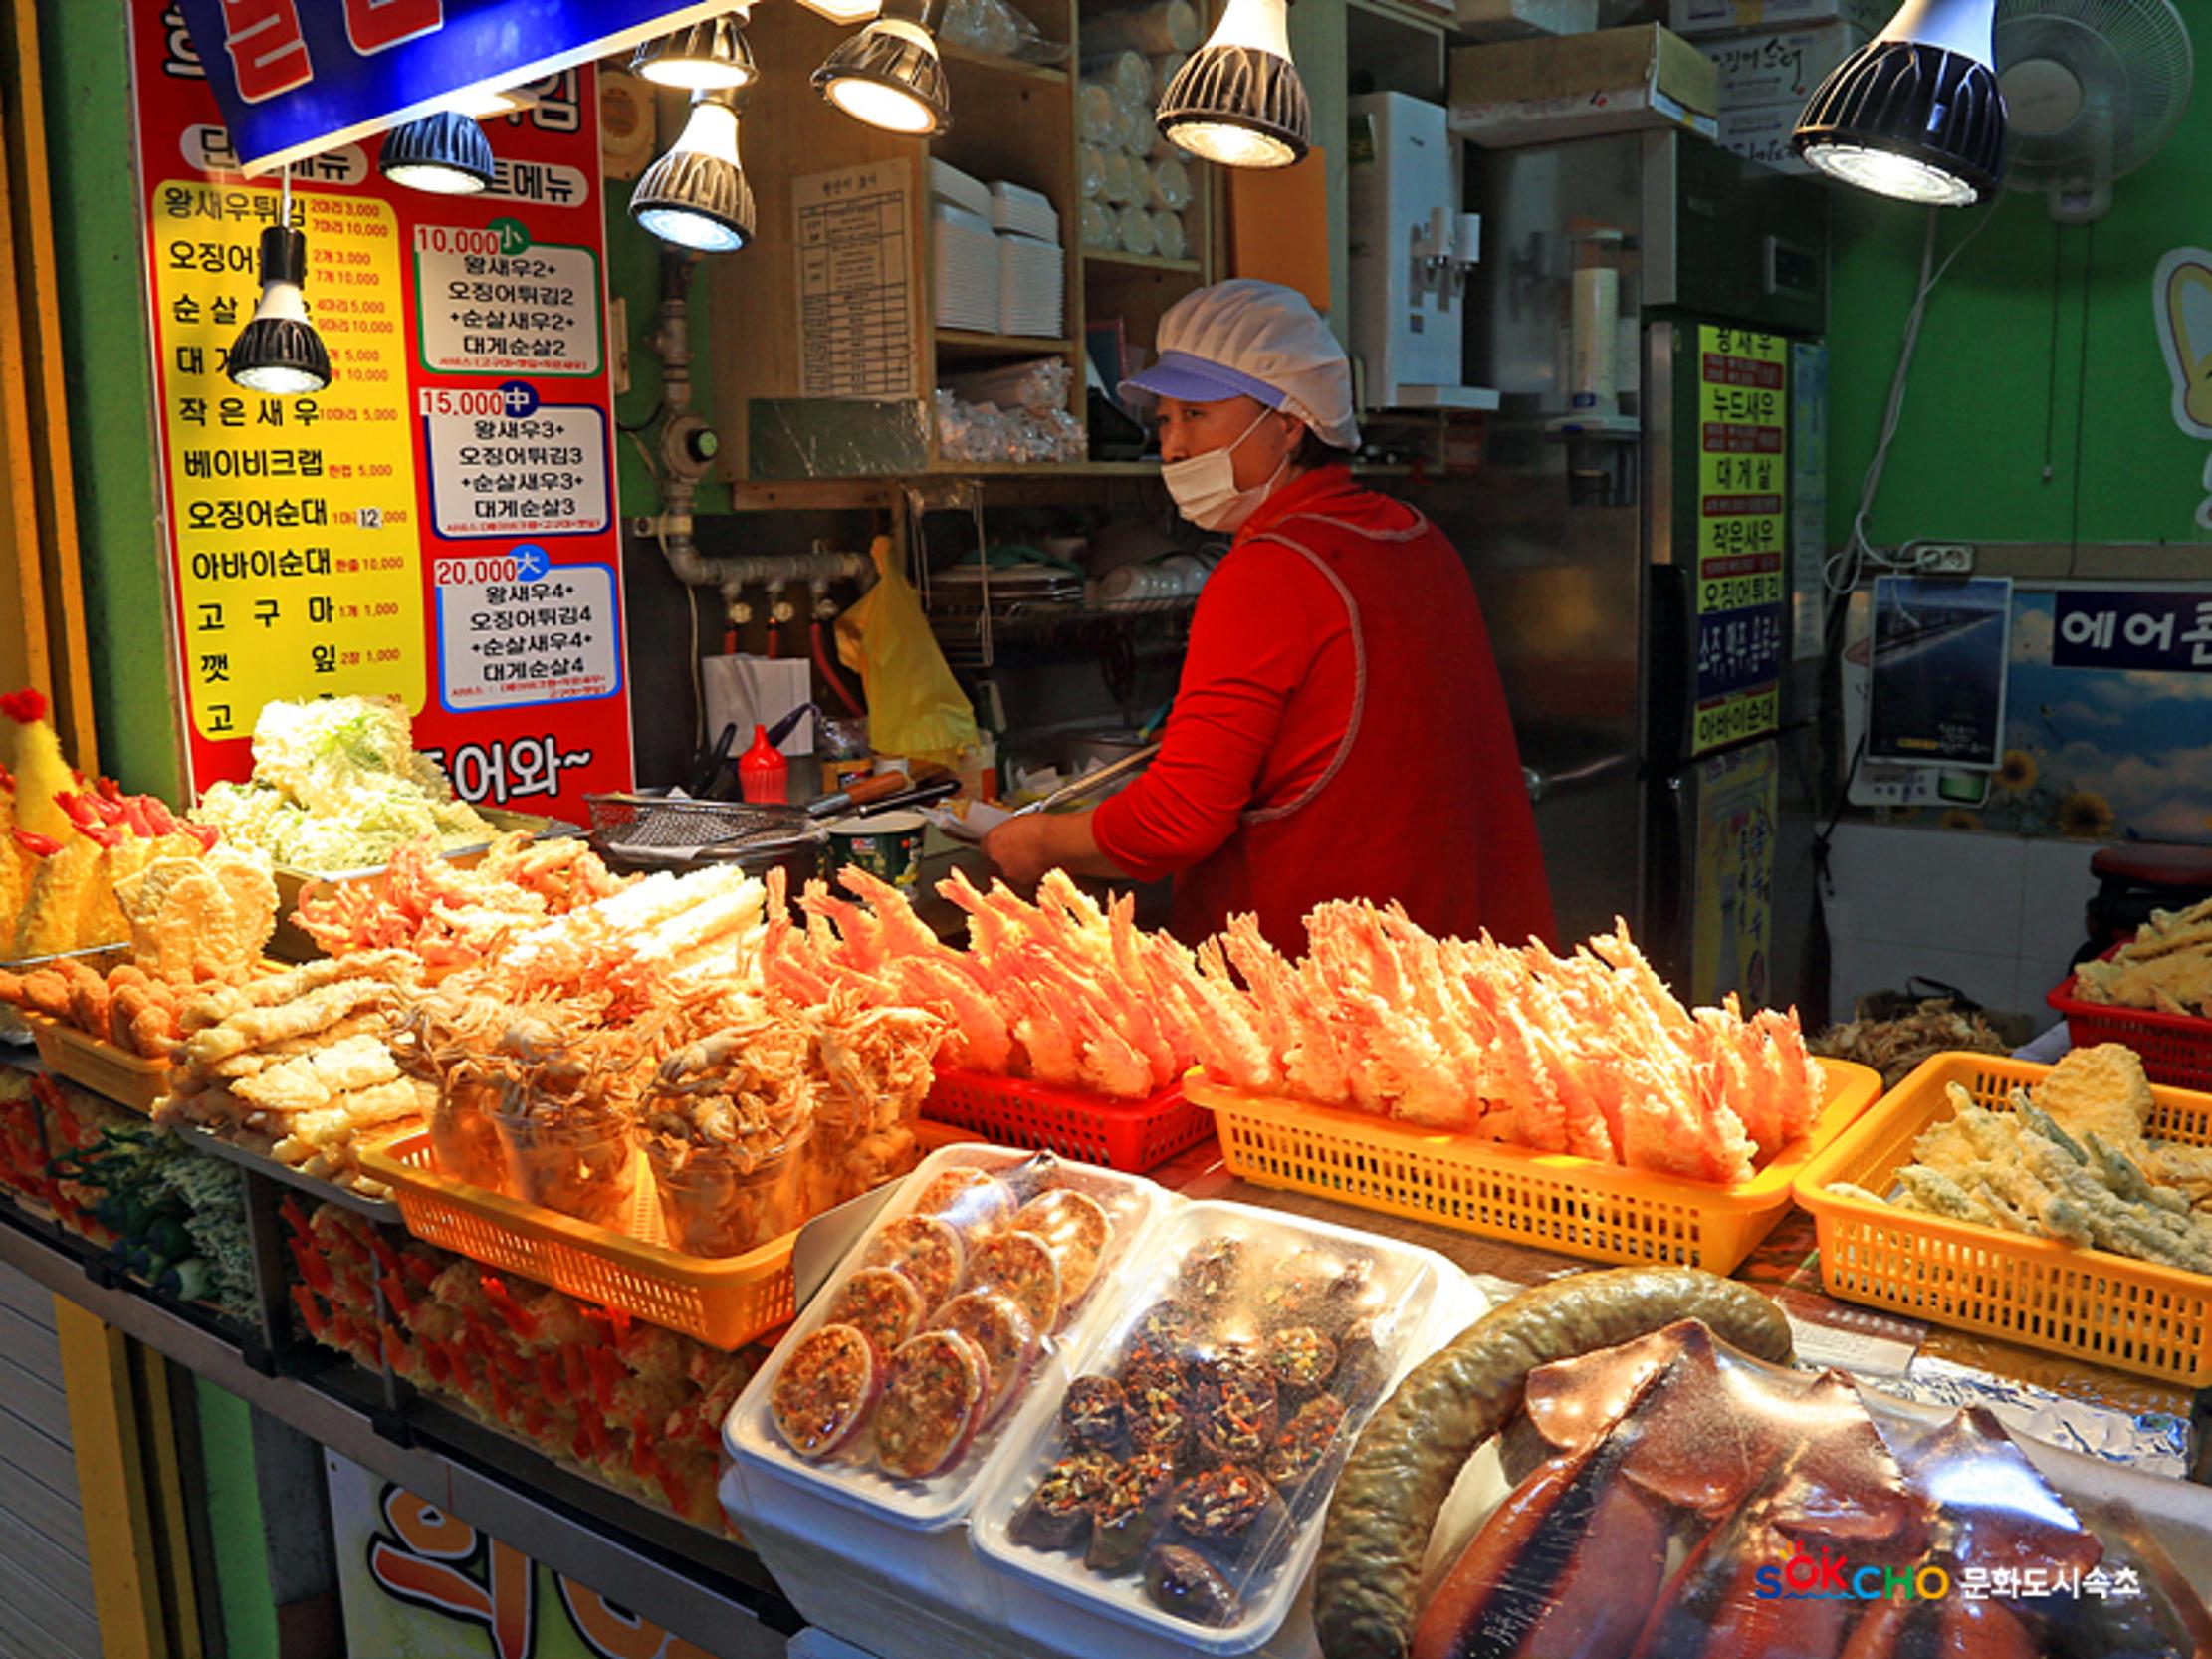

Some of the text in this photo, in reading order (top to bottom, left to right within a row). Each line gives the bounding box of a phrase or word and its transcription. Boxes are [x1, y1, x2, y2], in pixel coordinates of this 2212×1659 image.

[492, 161, 574, 203] 트메뉴
[346, 222, 389, 238] 10,000
[338, 272, 380, 287] 10,000
[448, 281, 575, 306] 오징어튀김2
[350, 299, 385, 315] 5,000
[352, 319, 394, 335] 10,000
[344, 349, 380, 363] 5,000
[463, 335, 567, 357] 대게순살2
[346, 369, 389, 384] 10,000
[505, 386, 530, 413] 中
[1713, 388, 1776, 424] 누드새우
[362, 408, 398, 422] 5,000
[183, 448, 324, 479] 베이비크랩
[459, 446, 584, 466] 오징어튀김3
[357, 464, 394, 478] 5,000
[1715, 456, 1773, 490] 대게살
[188, 498, 329, 530] 오징어순대
[474, 498, 576, 519] 대게순살3
[1712, 519, 1774, 554] 작은새우
[192, 547, 332, 581] 아바이순대
[362, 556, 404, 572] 10,000
[516, 551, 542, 575] 大
[364, 602, 399, 617] 1,000
[470, 605, 593, 631] 오징어튀김4
[365, 649, 401, 664] 1,000
[483, 656, 585, 682] 대게순살4
[1699, 695, 1773, 742] 아바이순대
